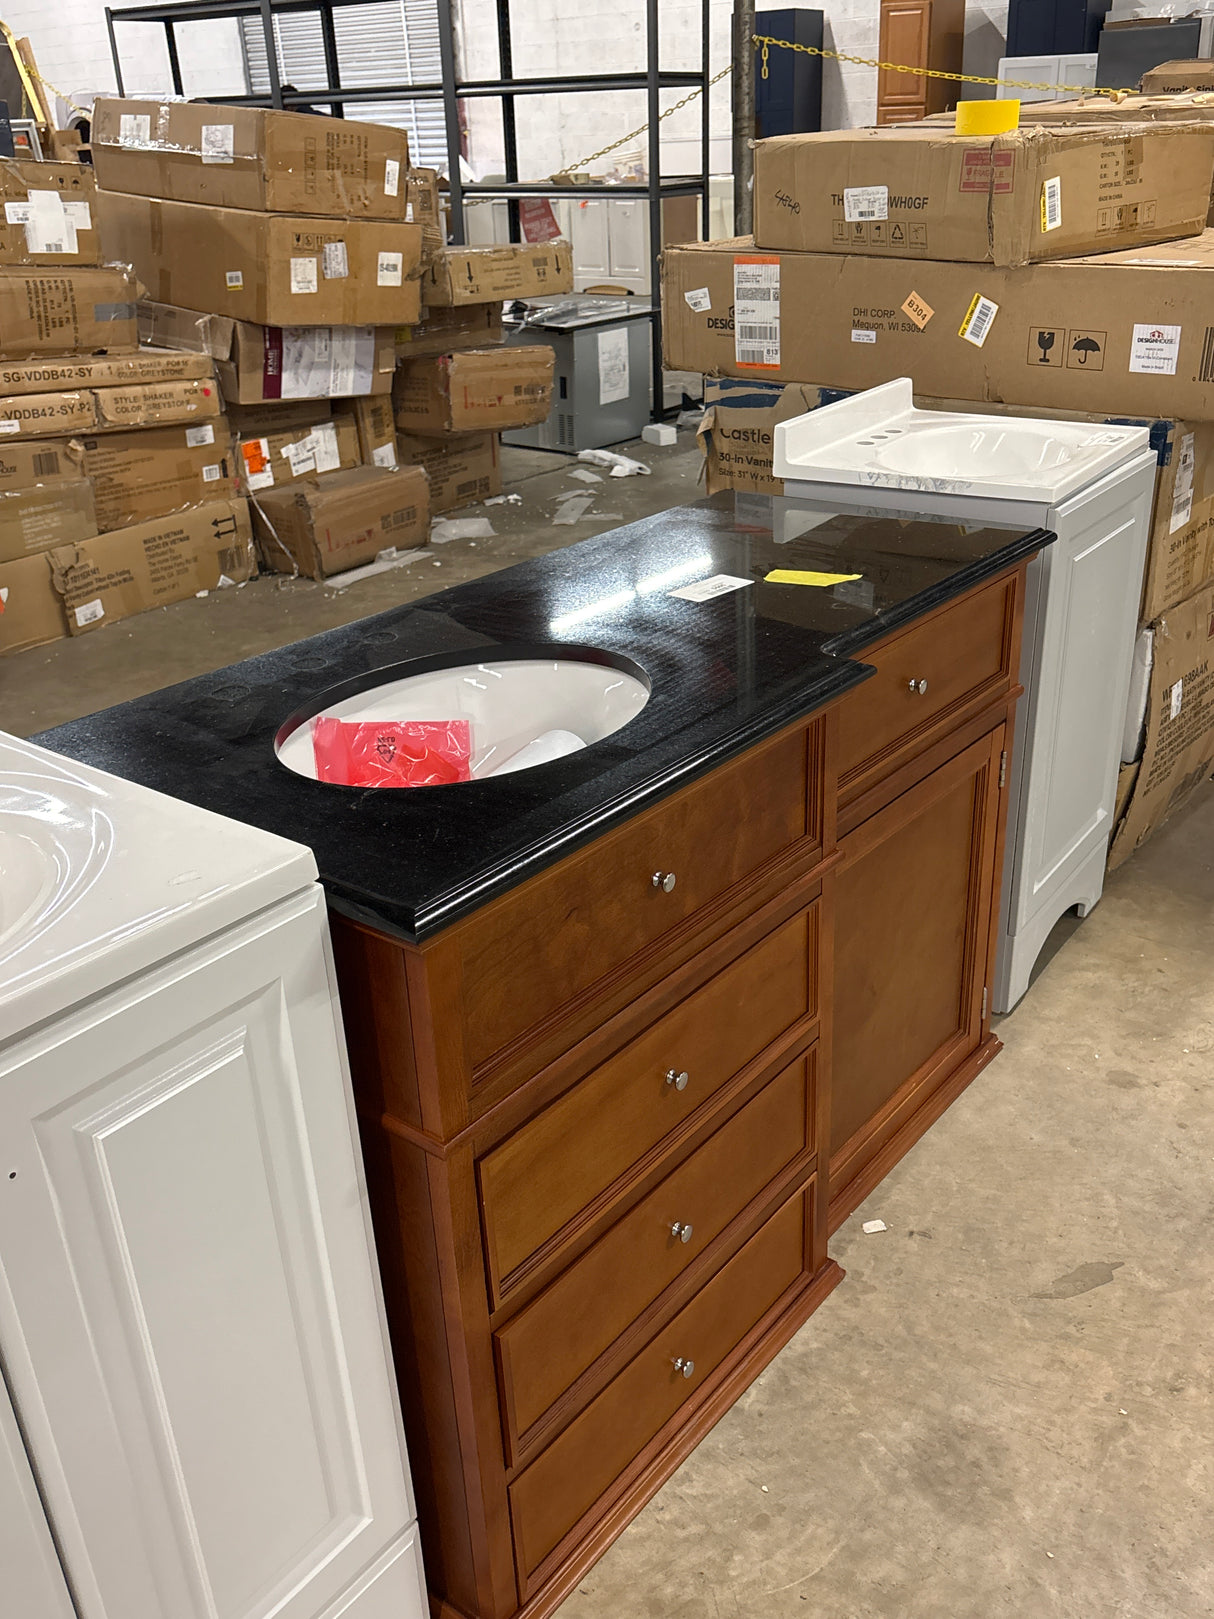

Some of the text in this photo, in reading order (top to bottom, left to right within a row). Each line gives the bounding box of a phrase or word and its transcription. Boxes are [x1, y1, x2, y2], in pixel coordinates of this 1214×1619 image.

[973, 168, 1005, 178] FRAGLE
[852, 307, 897, 319] DHI CORP.
[906, 298, 928, 321] B304
[852, 319, 886, 332] Mequon,
[887, 322, 899, 331] WI
[766, 348, 779, 356] 813
[3, 367, 93, 383] SG-VDDB42-SY
[114, 395, 138, 405] STYLE
[142, 391, 174, 402] SHAKER
[115, 404, 142, 414] COLOR
[720, 427, 771, 445] Castle
[750, 472, 760, 481] W
